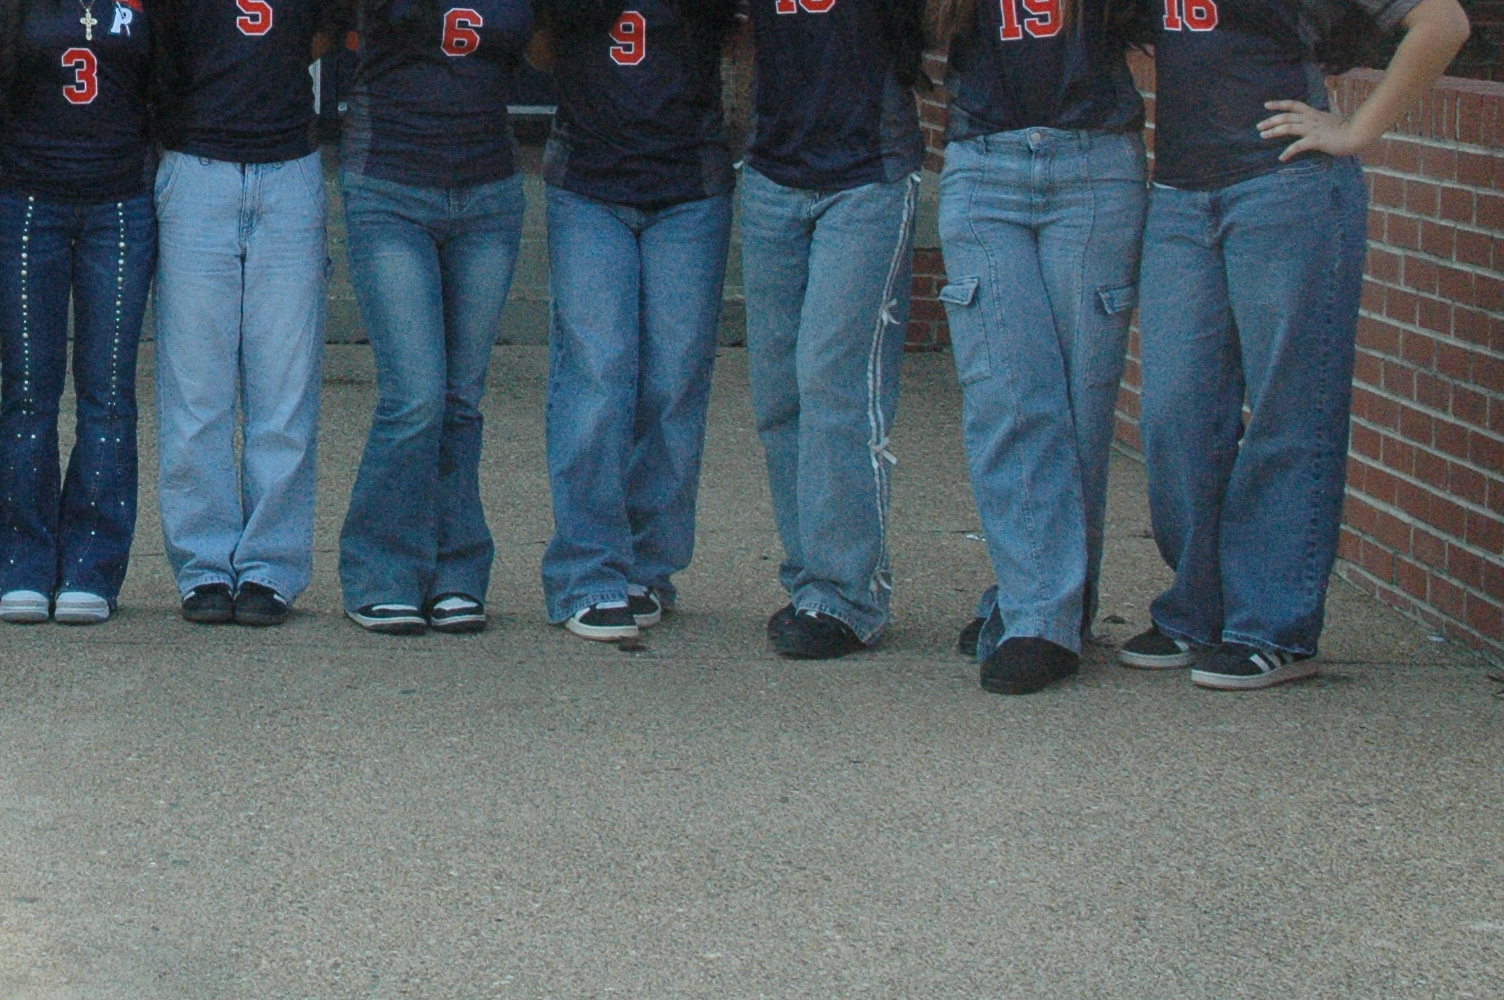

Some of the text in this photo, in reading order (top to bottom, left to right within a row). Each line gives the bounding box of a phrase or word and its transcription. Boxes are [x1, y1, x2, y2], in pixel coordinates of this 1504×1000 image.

[441, 7, 484, 57] 6
[609, 10, 647, 66] 9
[60, 47, 99, 105] 3
